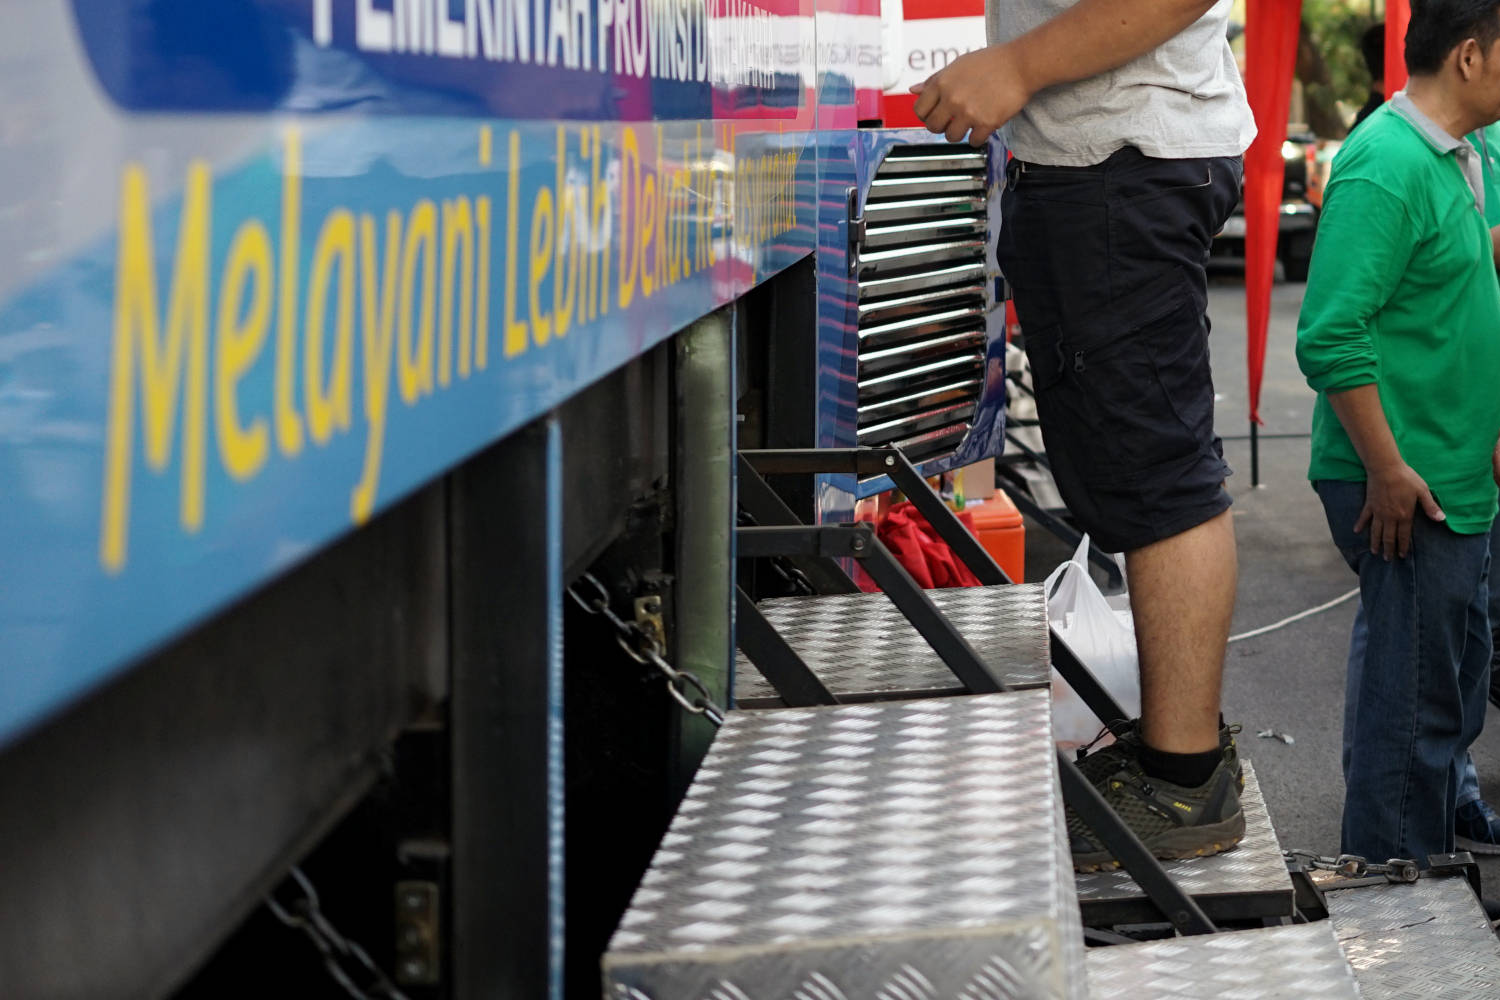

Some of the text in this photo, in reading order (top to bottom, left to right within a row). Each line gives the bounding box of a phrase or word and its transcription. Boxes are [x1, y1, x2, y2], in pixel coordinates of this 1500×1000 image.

[100, 124, 494, 573] Melayani
[504, 124, 609, 358] Lebih
[618, 124, 691, 309] Dekat
